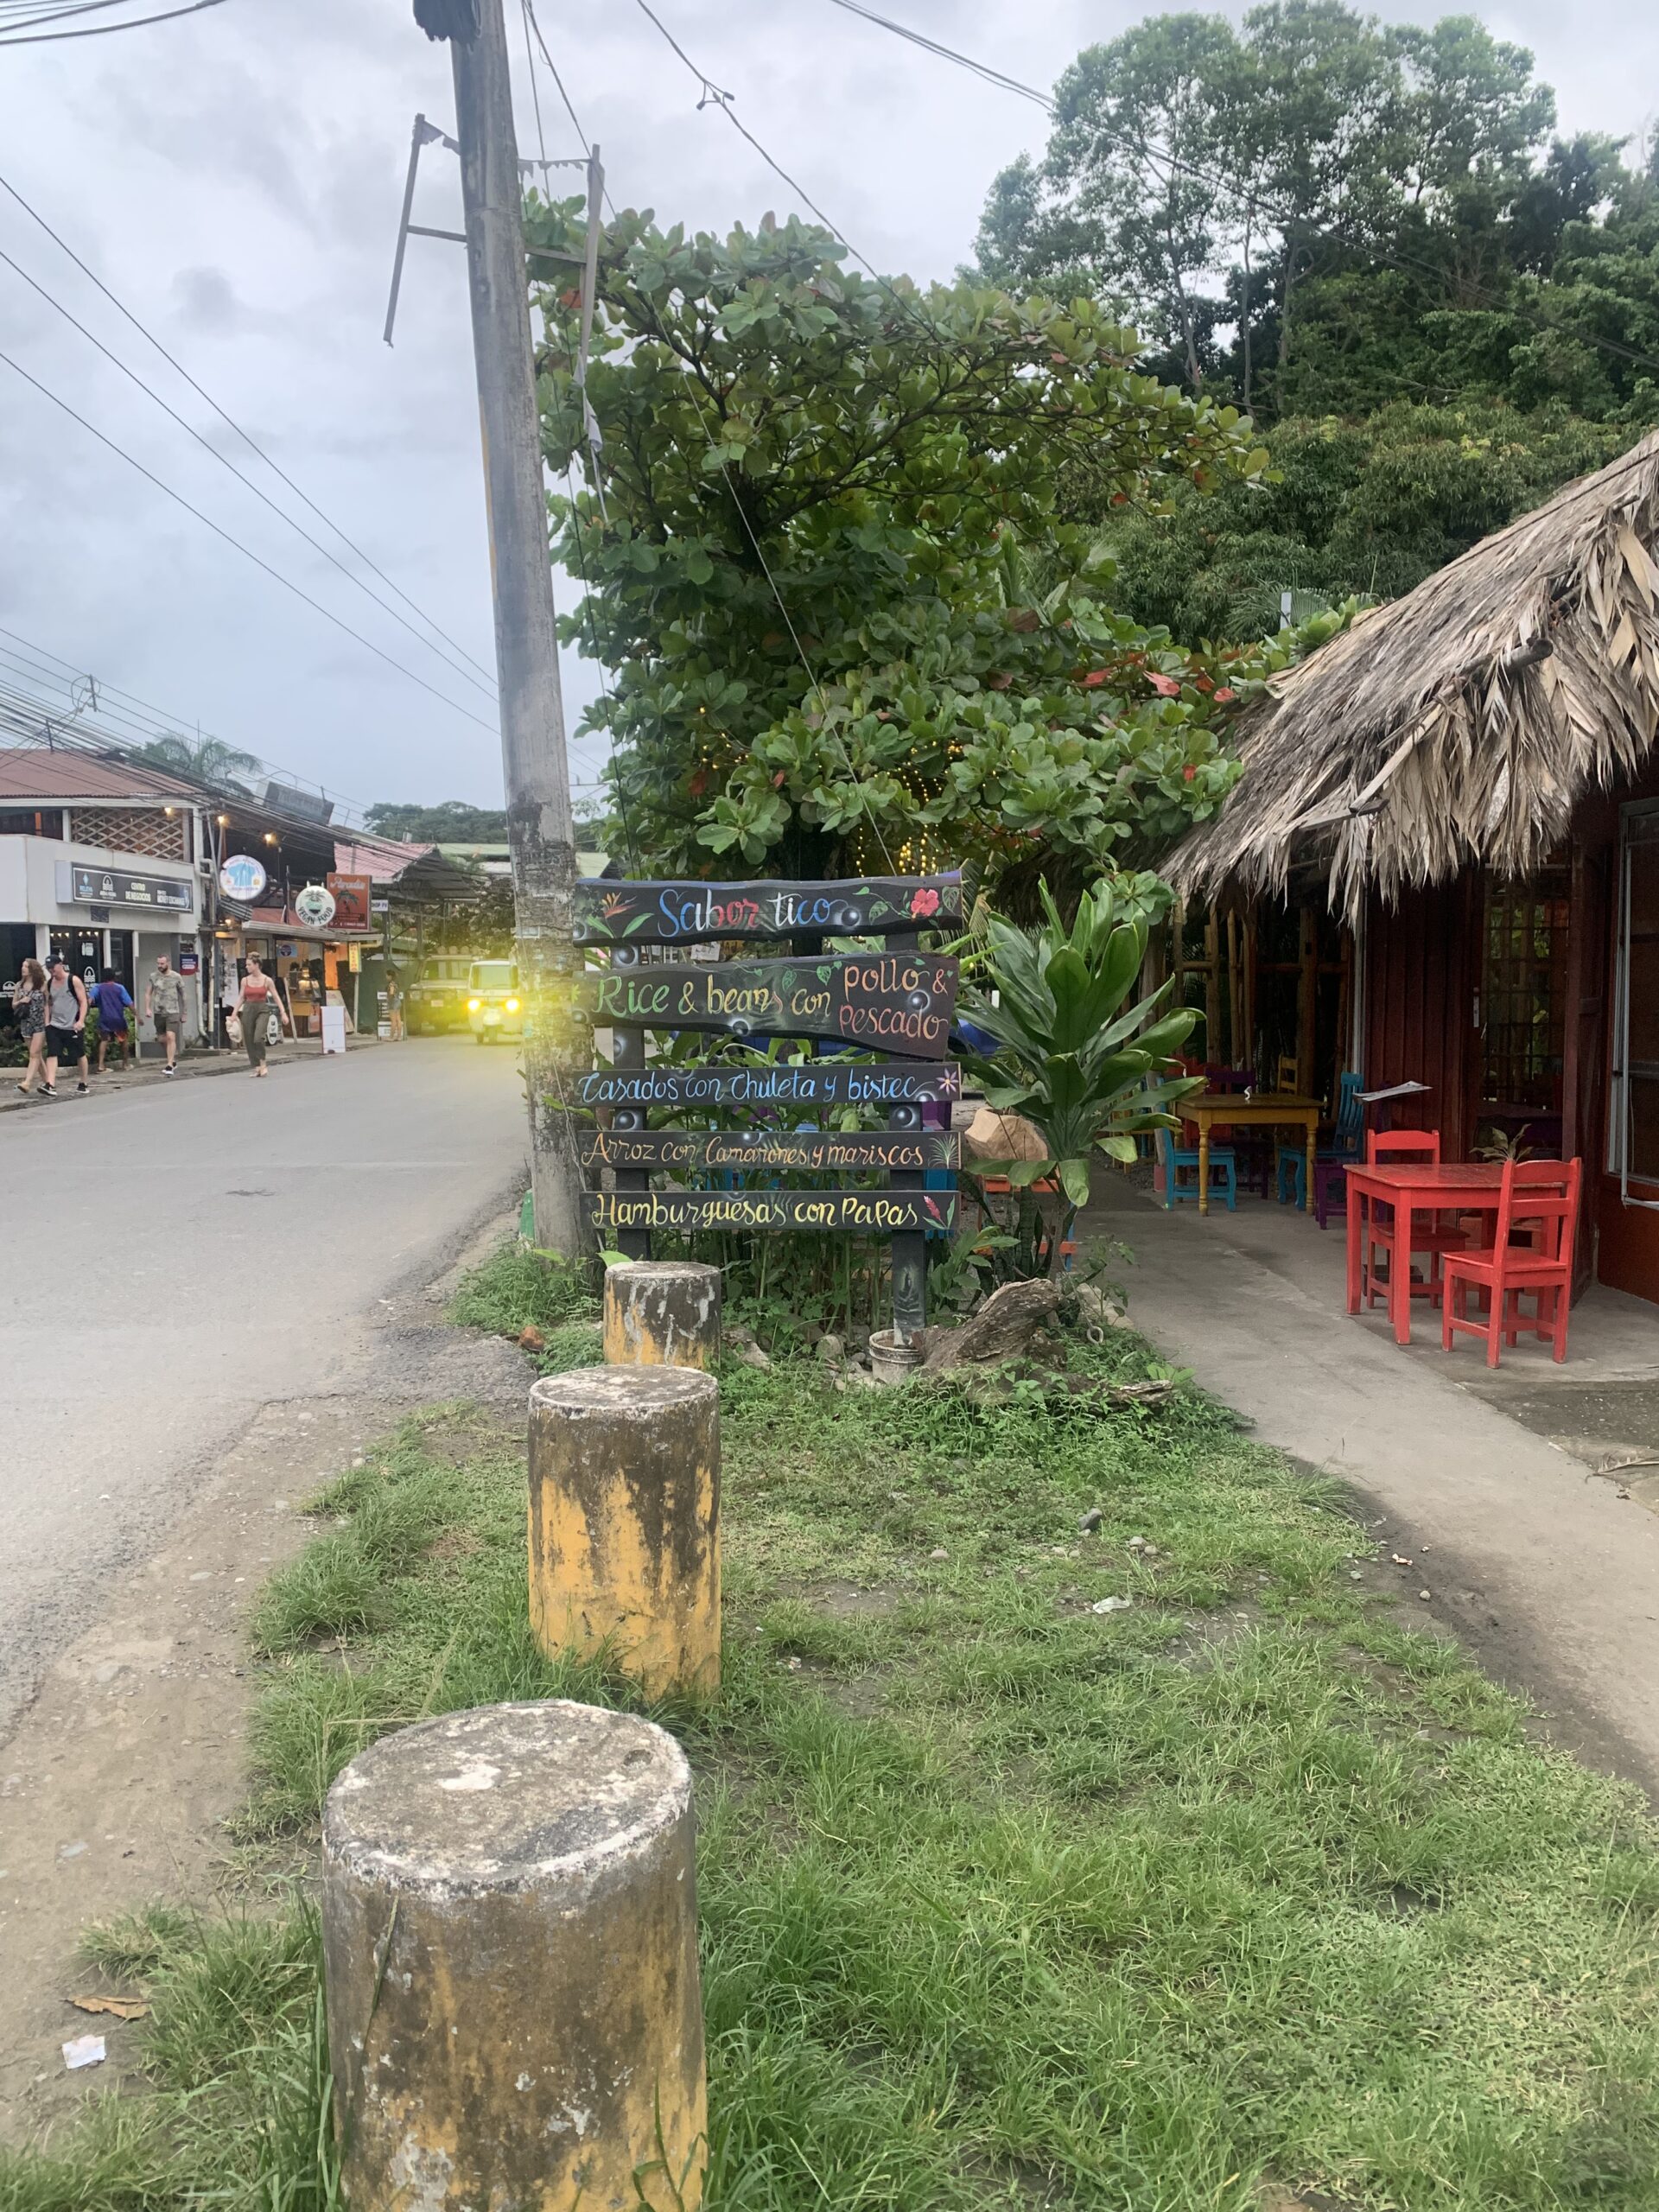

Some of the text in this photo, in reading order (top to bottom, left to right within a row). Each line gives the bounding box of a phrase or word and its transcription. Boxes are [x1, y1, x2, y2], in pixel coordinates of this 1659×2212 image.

[297, 906, 315, 925] VEGAN
[317, 906, 333, 925] FOOD
[658, 888, 849, 938] Sabor tico
[591, 976, 670, 1018] Rice
[678, 982, 699, 1014] &
[708, 975, 784, 1014] beans
[932, 969, 948, 995] &
[578, 1071, 678, 1103] Casados
[823, 1075, 837, 1102] y
[848, 1068, 933, 1101] bistec
[581, 1133, 924, 1168] Arroz con Camarones y mariscos
[591, 1193, 786, 1228] Hamburguesas
[794, 1201, 837, 1227] con
